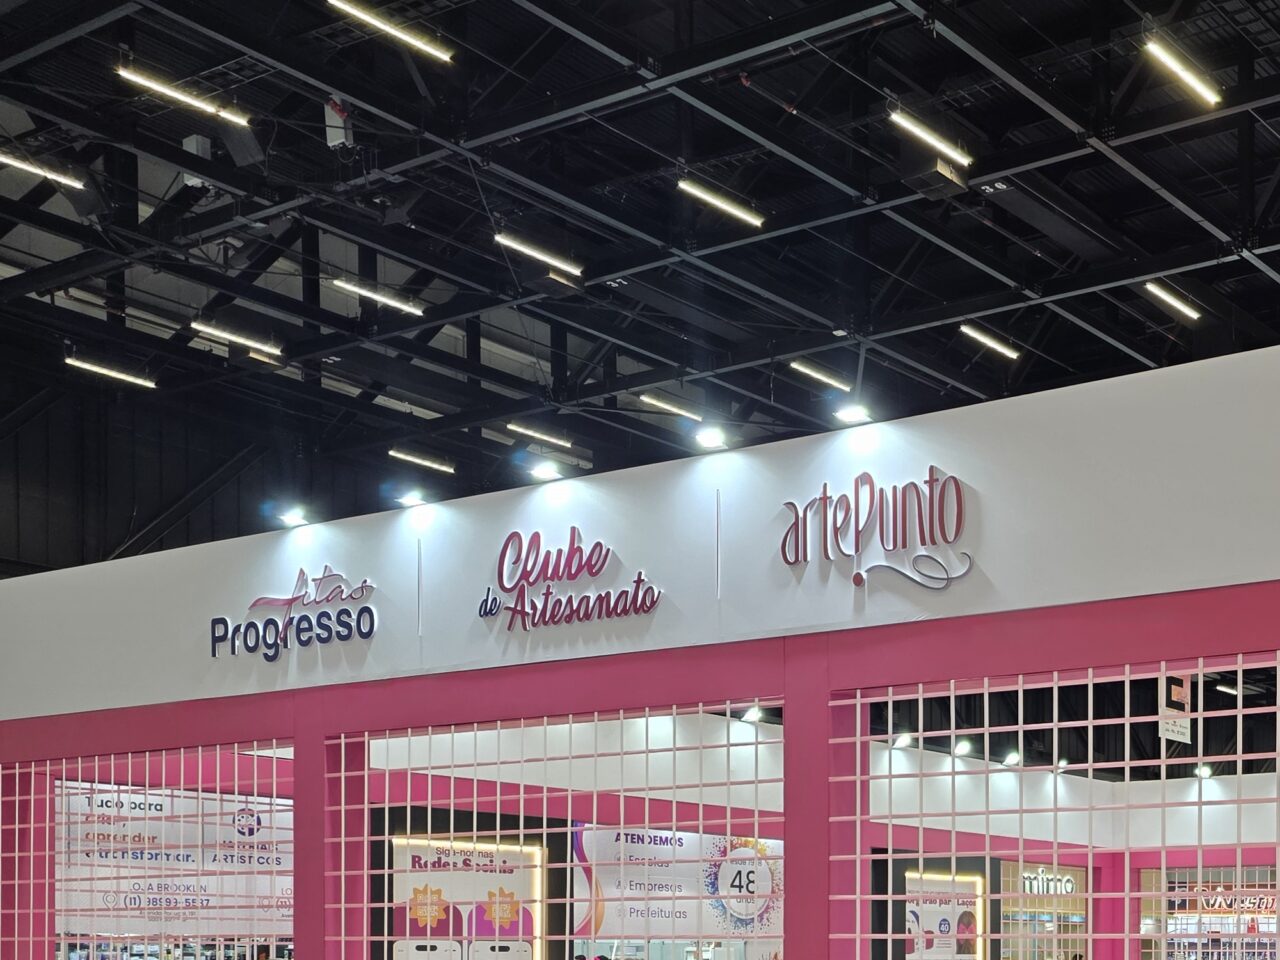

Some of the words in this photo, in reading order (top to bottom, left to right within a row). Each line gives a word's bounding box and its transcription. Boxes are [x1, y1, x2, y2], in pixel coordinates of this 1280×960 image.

[781, 465, 966, 568] artePunto
[497, 526, 613, 594] Clube
[479, 586, 501, 618] de
[502, 571, 661, 633] Artesanato
[211, 606, 375, 662] Progresso
[478, 850, 494, 859] nas
[157, 883, 207, 893] BROOKLN
